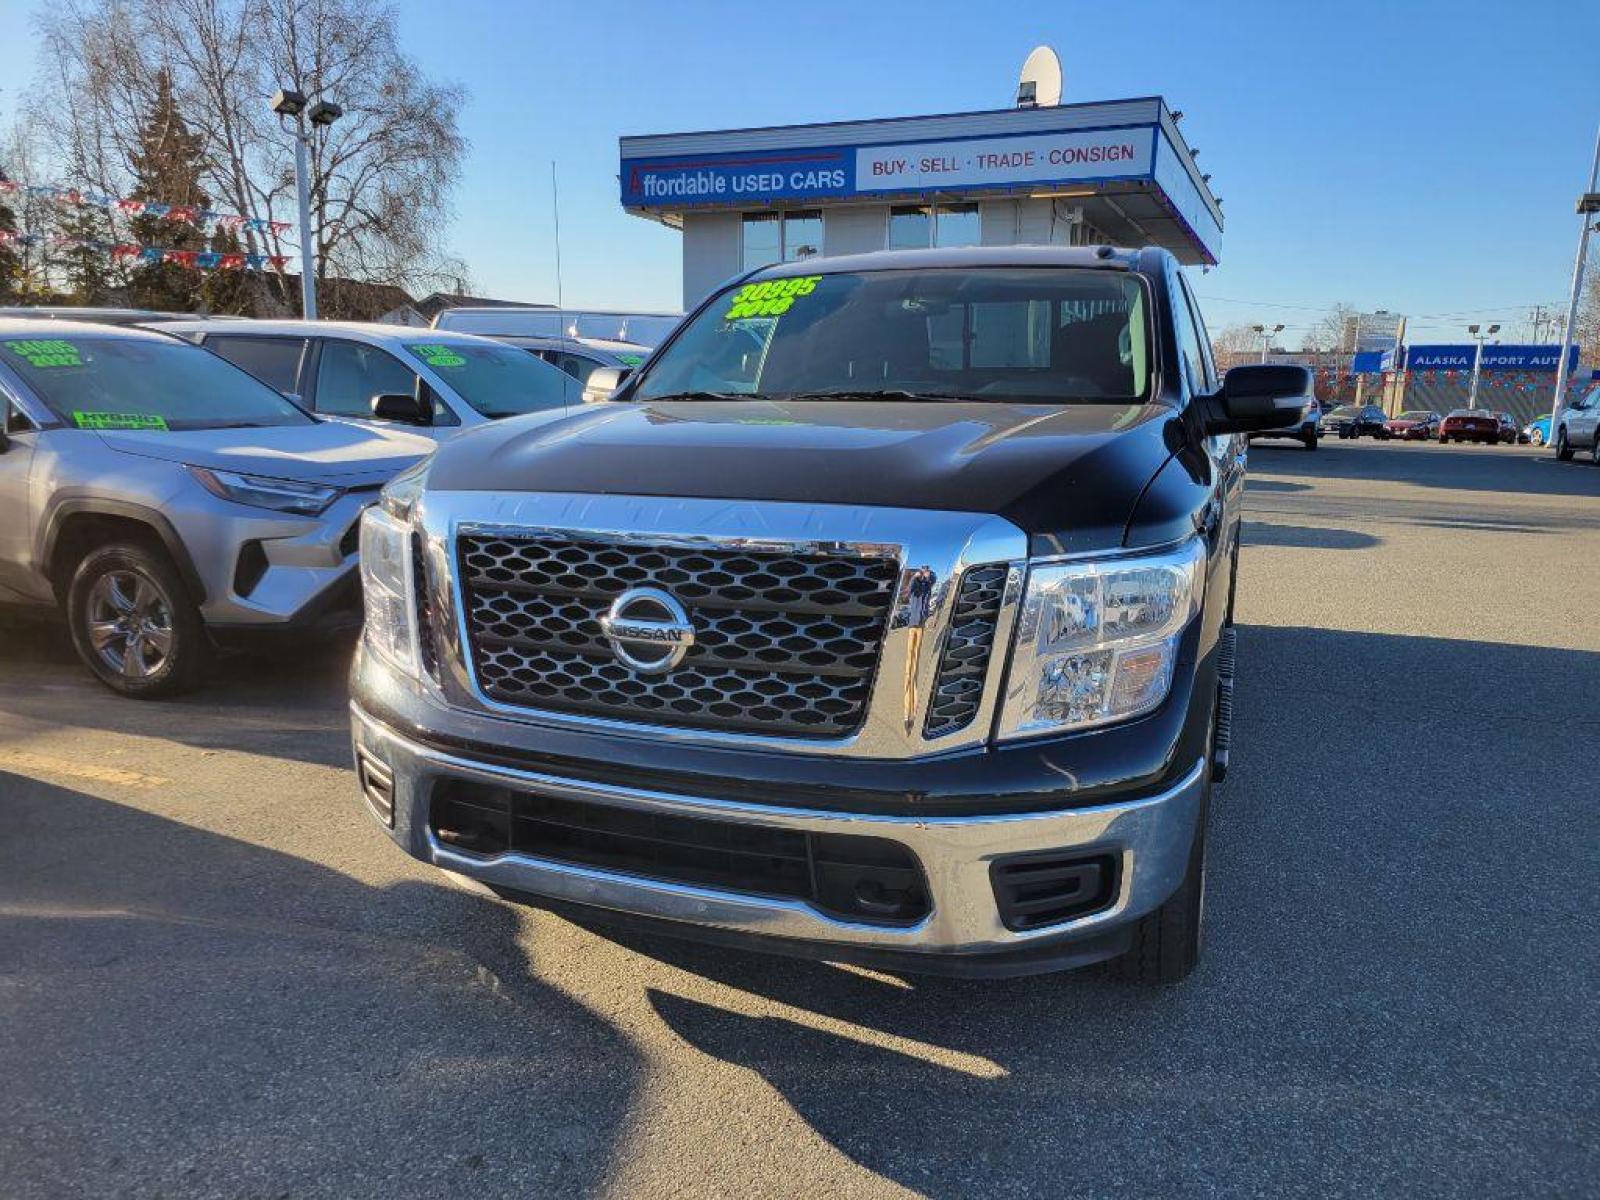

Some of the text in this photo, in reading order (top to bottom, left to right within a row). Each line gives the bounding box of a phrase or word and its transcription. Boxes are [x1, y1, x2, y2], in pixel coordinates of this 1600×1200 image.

[872, 144, 1134, 176] BUY SELL TRADE CONSIGN
[630, 164, 845, 197] Affordable USED CARS
[1415, 356, 1561, 365] ALASKA MPORT AUT
[612, 623, 682, 641] NISSAN
